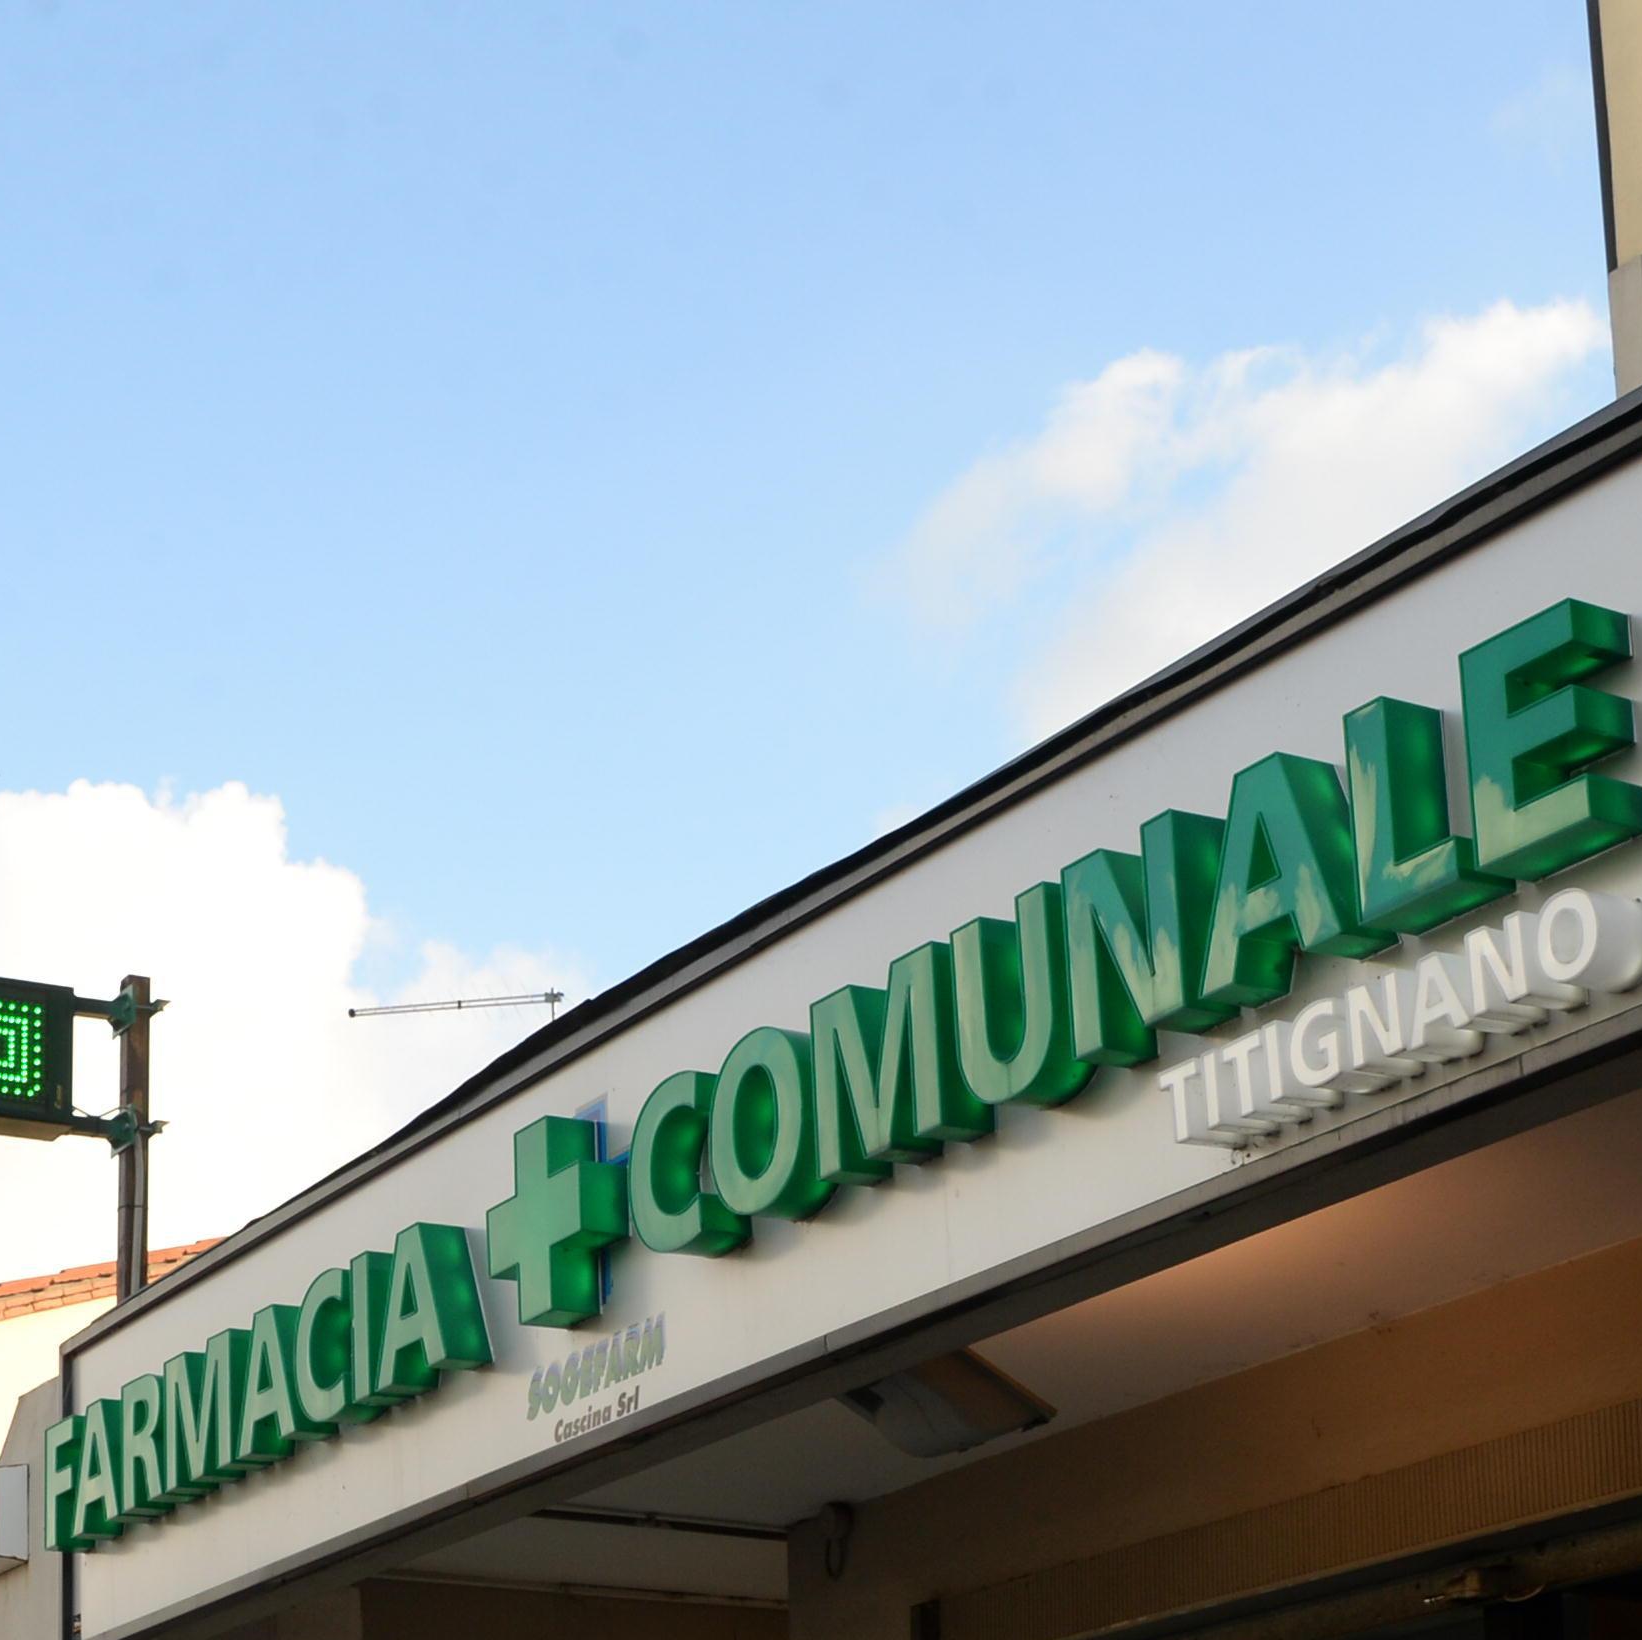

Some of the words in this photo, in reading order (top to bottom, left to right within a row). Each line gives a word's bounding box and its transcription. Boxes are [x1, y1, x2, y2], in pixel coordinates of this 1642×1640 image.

[44, 1223, 494, 1552] FARMACIA
[527, 1312, 665, 1421] SOGEFARM
[554, 1404, 612, 1442] Cascina
[617, 1385, 640, 1417] Srl
